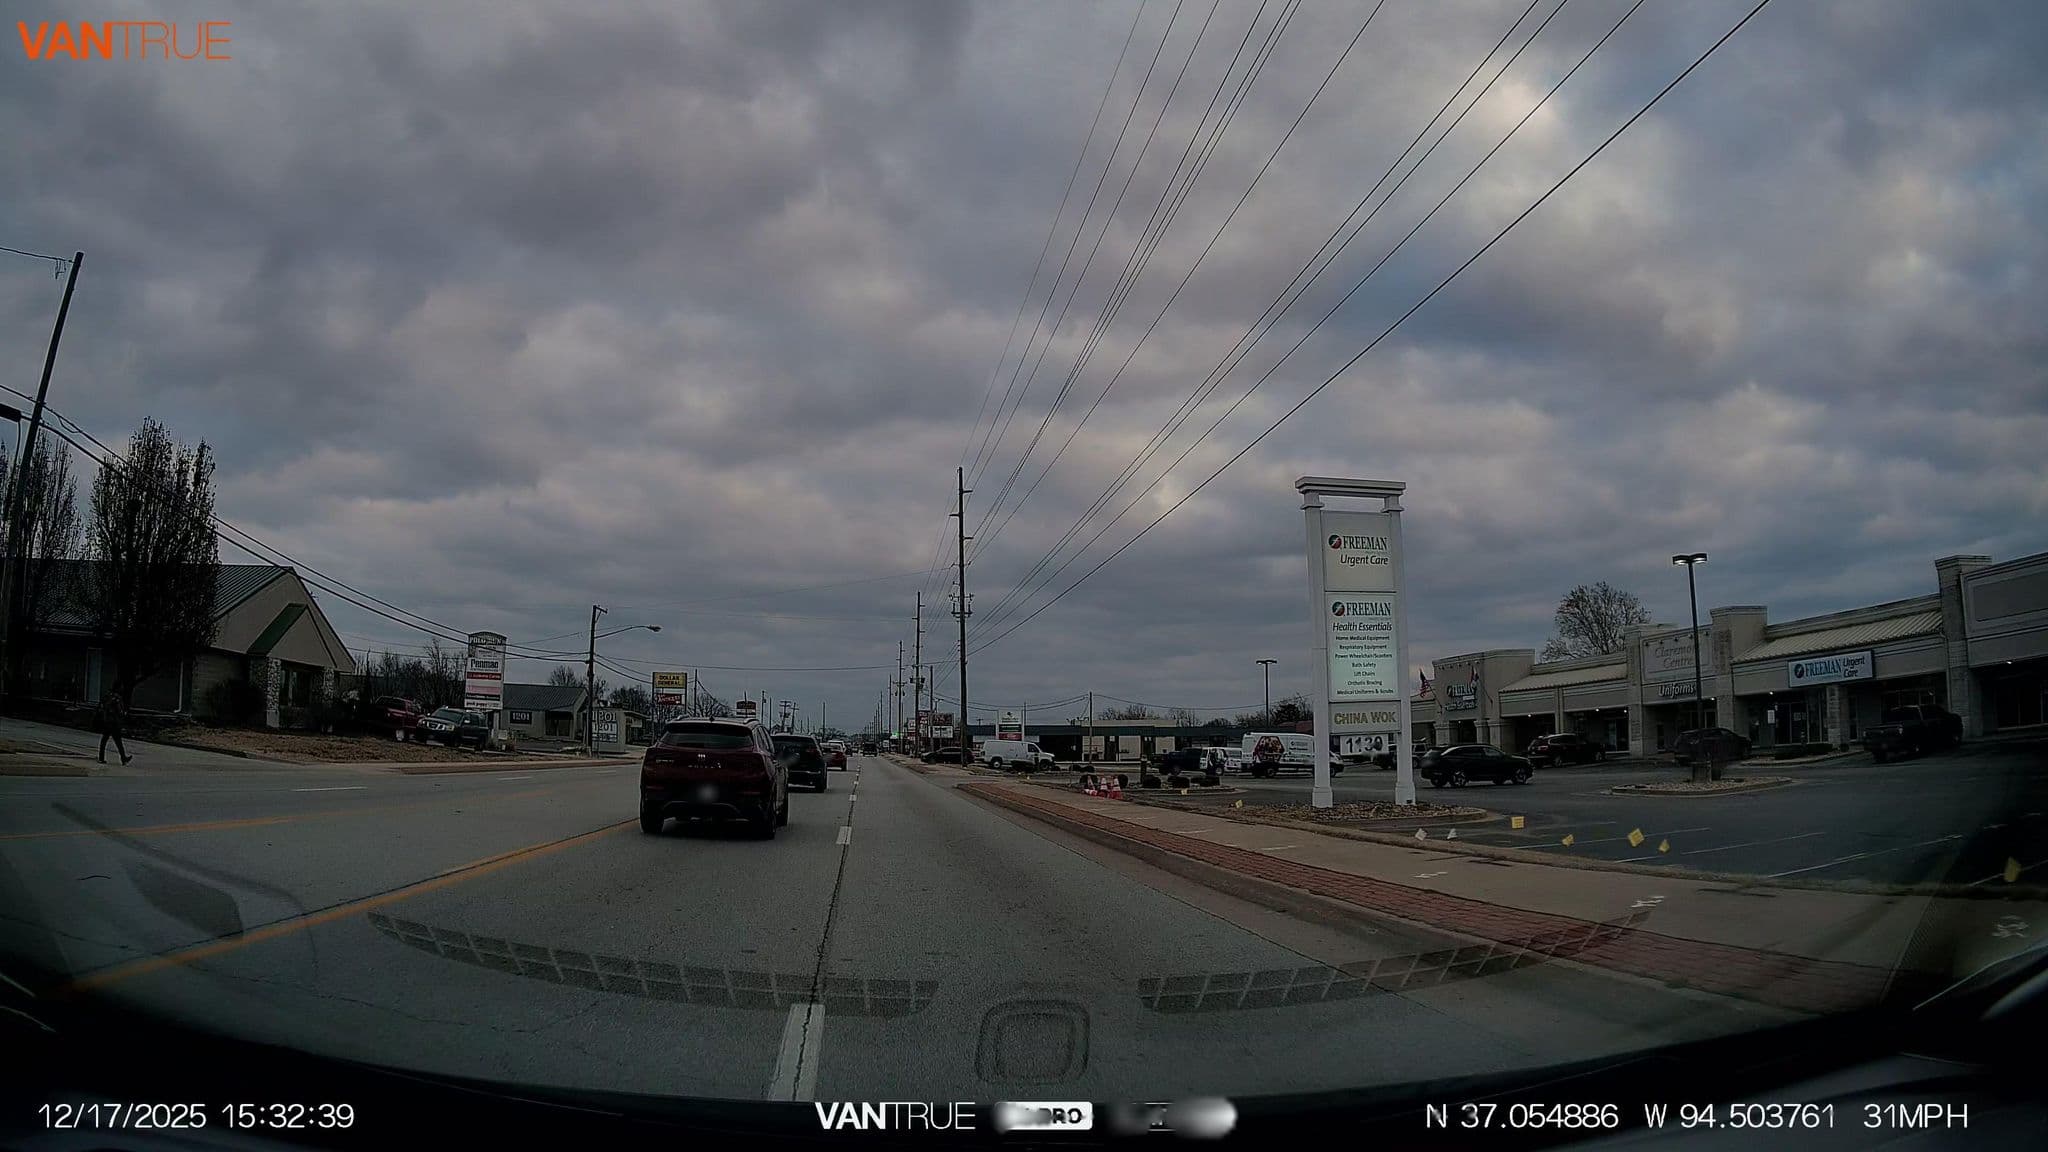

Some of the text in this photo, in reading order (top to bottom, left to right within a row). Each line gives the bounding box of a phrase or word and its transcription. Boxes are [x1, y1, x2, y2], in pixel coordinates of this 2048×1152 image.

[1342, 536, 1388, 550] FREEMAN
[1340, 554, 1389, 567] Urgent Care
[1346, 602, 1391, 616] FREEMAN
[1332, 622, 1392, 632] Health Essentials
[1805, 656, 1865, 677] FREEMAN Urgent
[1844, 669, 1858, 678] Care
[1658, 682, 1696, 698] Uniforms
[512, 712, 530, 721] 1201
[1334, 711, 1397, 724] CHINA WOK
